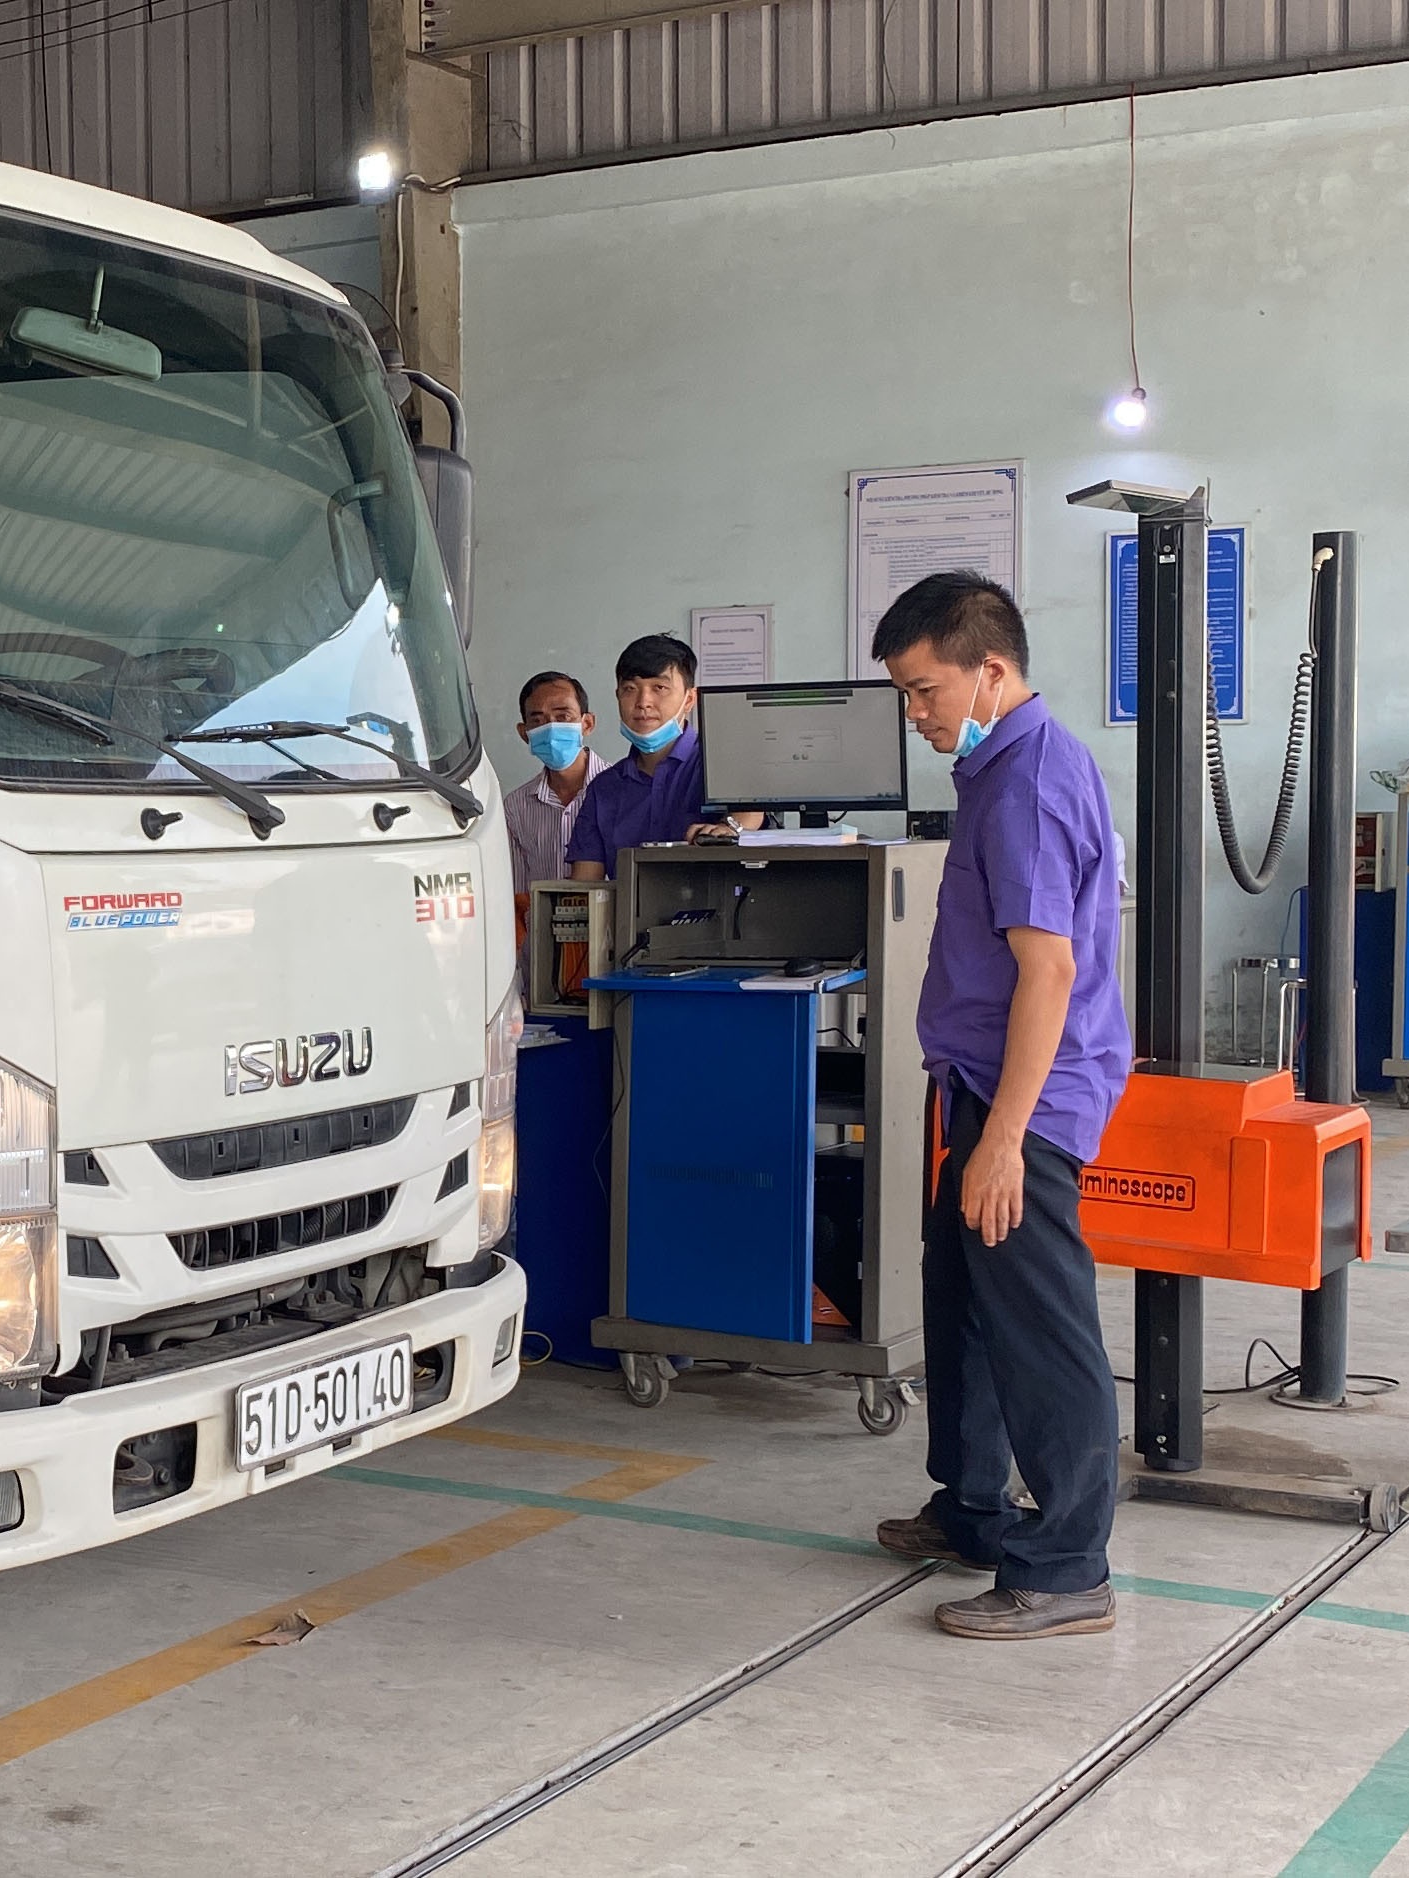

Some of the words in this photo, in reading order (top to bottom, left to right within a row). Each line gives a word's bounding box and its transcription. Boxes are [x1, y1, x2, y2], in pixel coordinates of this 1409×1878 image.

[413, 872, 474, 897] NMR
[63, 892, 183, 911] FORWARD
[415, 895, 475, 922] 310
[224, 1026, 373, 1097] ISUZU
[245, 1347, 404, 1456] 51D-501.40
